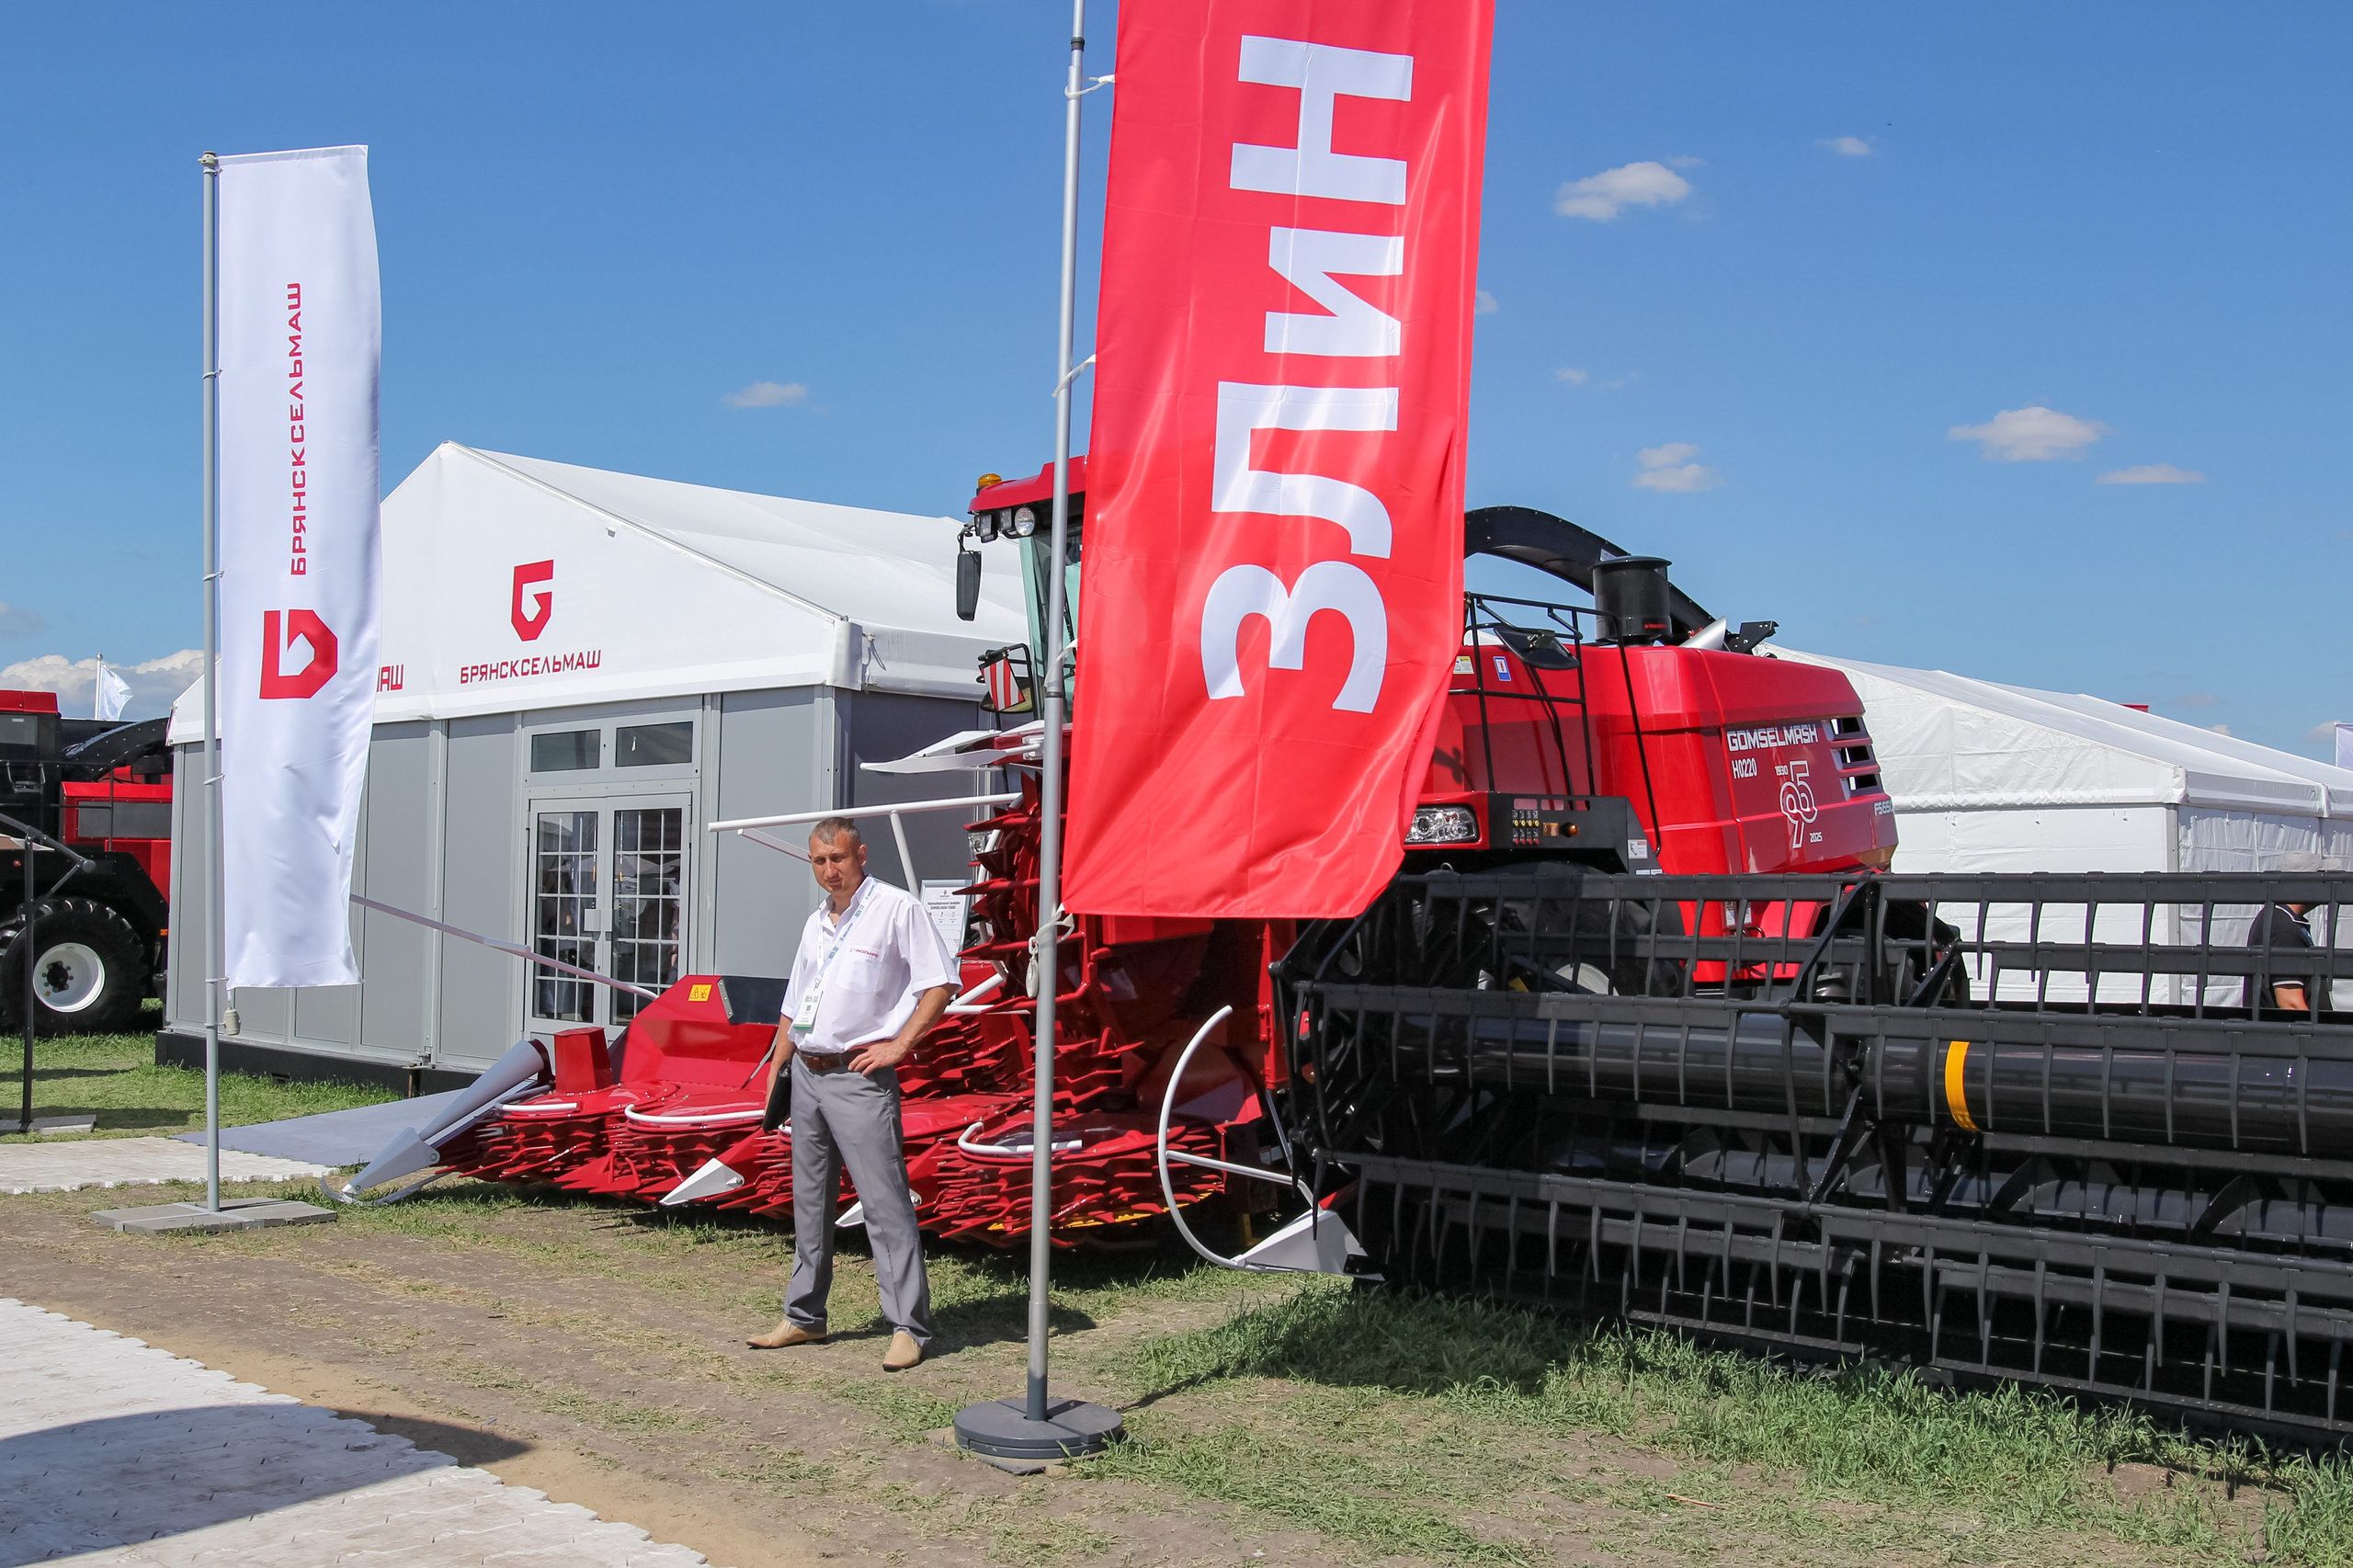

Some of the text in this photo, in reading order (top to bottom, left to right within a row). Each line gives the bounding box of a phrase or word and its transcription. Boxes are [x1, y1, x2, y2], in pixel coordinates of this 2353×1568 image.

[287, 282, 307, 576] БРЯНСКСЕЛЬМАШ
[377, 664, 404, 692] АШ
[460, 649, 601, 684] БРЯНСКСЕЛЬМАШ
[1726, 724, 1819, 751] GOMSELMASH
[1775, 765, 1789, 776] 1930
[1809, 832, 1823, 843] 2025
